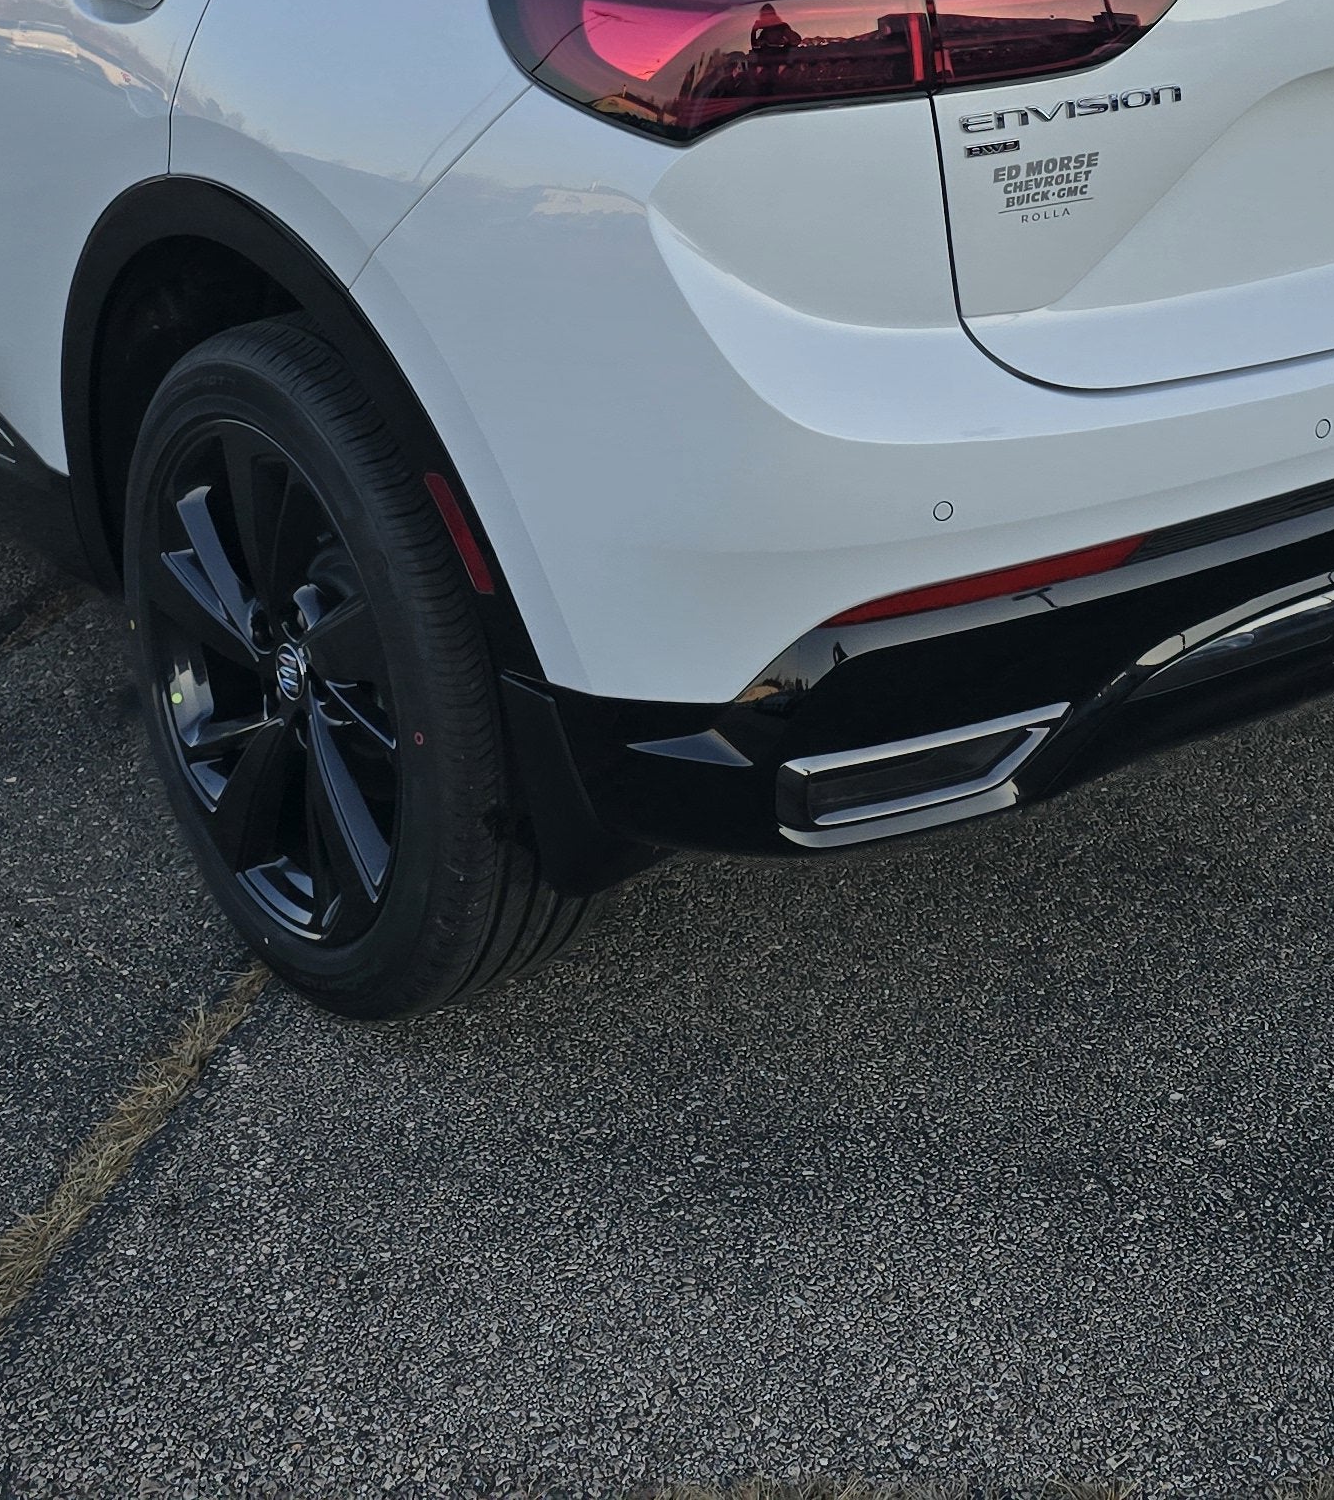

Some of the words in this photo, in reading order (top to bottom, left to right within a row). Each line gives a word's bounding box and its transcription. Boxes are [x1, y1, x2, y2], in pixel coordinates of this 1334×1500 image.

[959, 83, 1182, 133] ENVISION
[993, 165, 1021, 183] ED
[1025, 152, 1099, 177] MORSE
[1003, 170, 1092, 195] CHEVROLET
[1021, 207, 1071, 223] ROLLA
